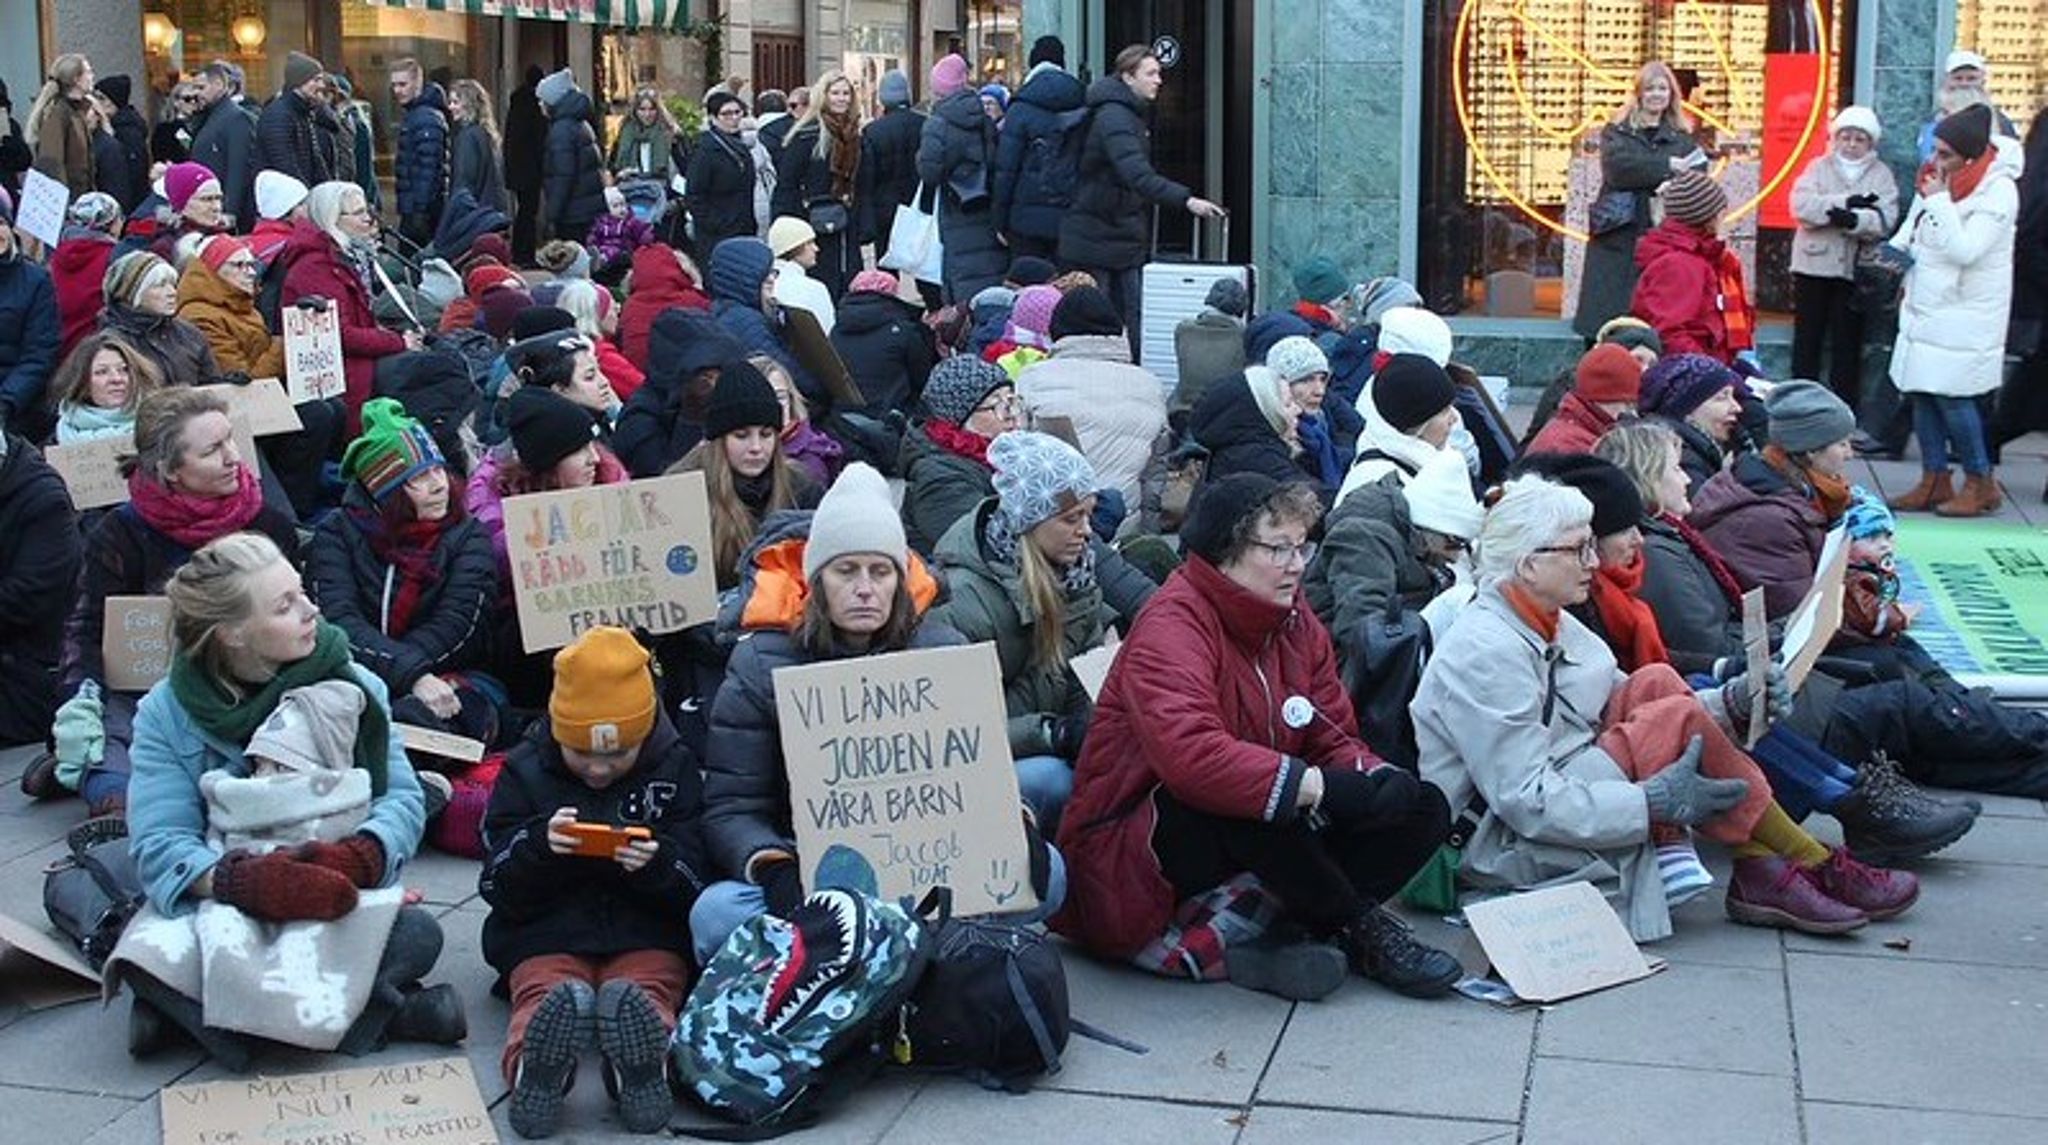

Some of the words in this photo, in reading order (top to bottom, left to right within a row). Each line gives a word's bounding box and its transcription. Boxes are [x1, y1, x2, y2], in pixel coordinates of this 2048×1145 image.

[524, 500, 599, 548] JAG
[617, 488, 672, 534] ÄR
[520, 551, 586, 590] RÄDD
[601, 540, 649, 576] FÖR
[569, 600, 688, 637] FRAMTID
[791, 686, 825, 729] VI
[840, 676, 940, 725] LÅNAR
[820, 729, 934, 787] JORDEN
[943, 725, 981, 768] AV
[807, 787, 878, 831] VÅRA
[886, 781, 966, 823] BARN
[871, 831, 963, 869] Jacob
